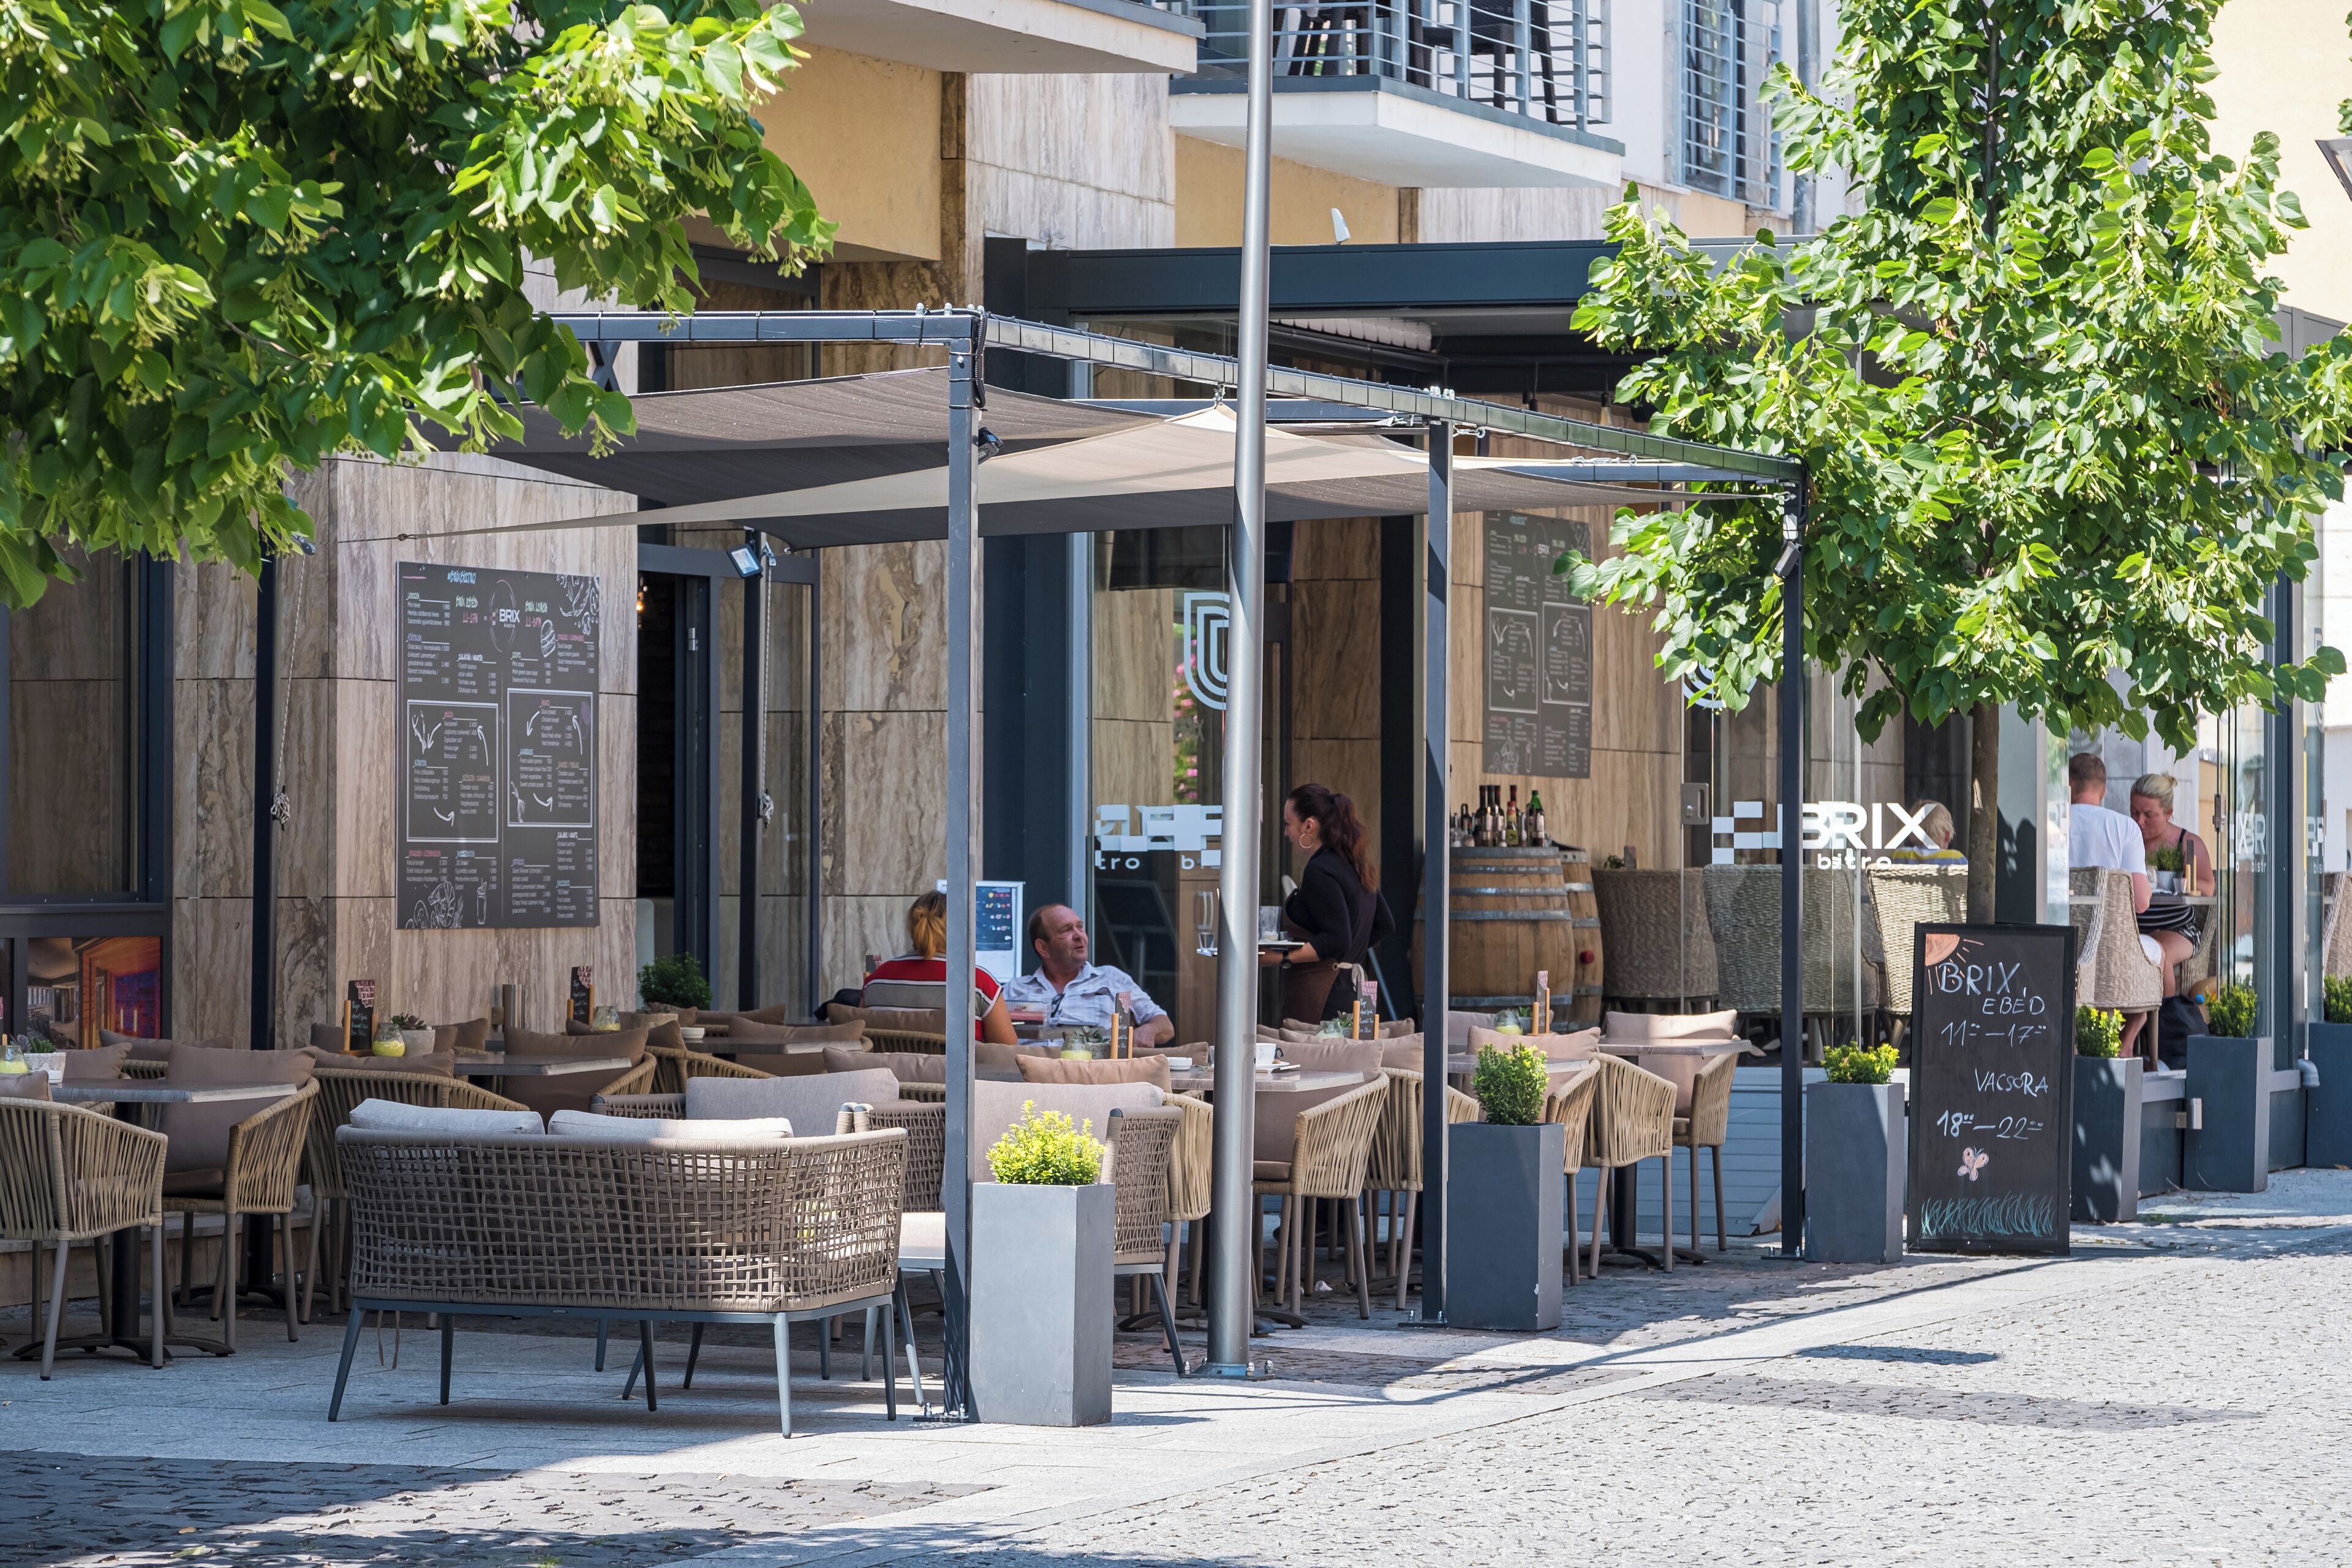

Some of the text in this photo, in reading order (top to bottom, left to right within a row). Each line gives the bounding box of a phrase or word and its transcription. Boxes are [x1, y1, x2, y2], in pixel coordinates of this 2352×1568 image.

[499, 609, 520, 623] BRIX
[1938, 961, 2021, 995] BRIX
[1982, 987, 2045, 1015] EBÉD
[1975, 1068, 2049, 1097] VACSORA
